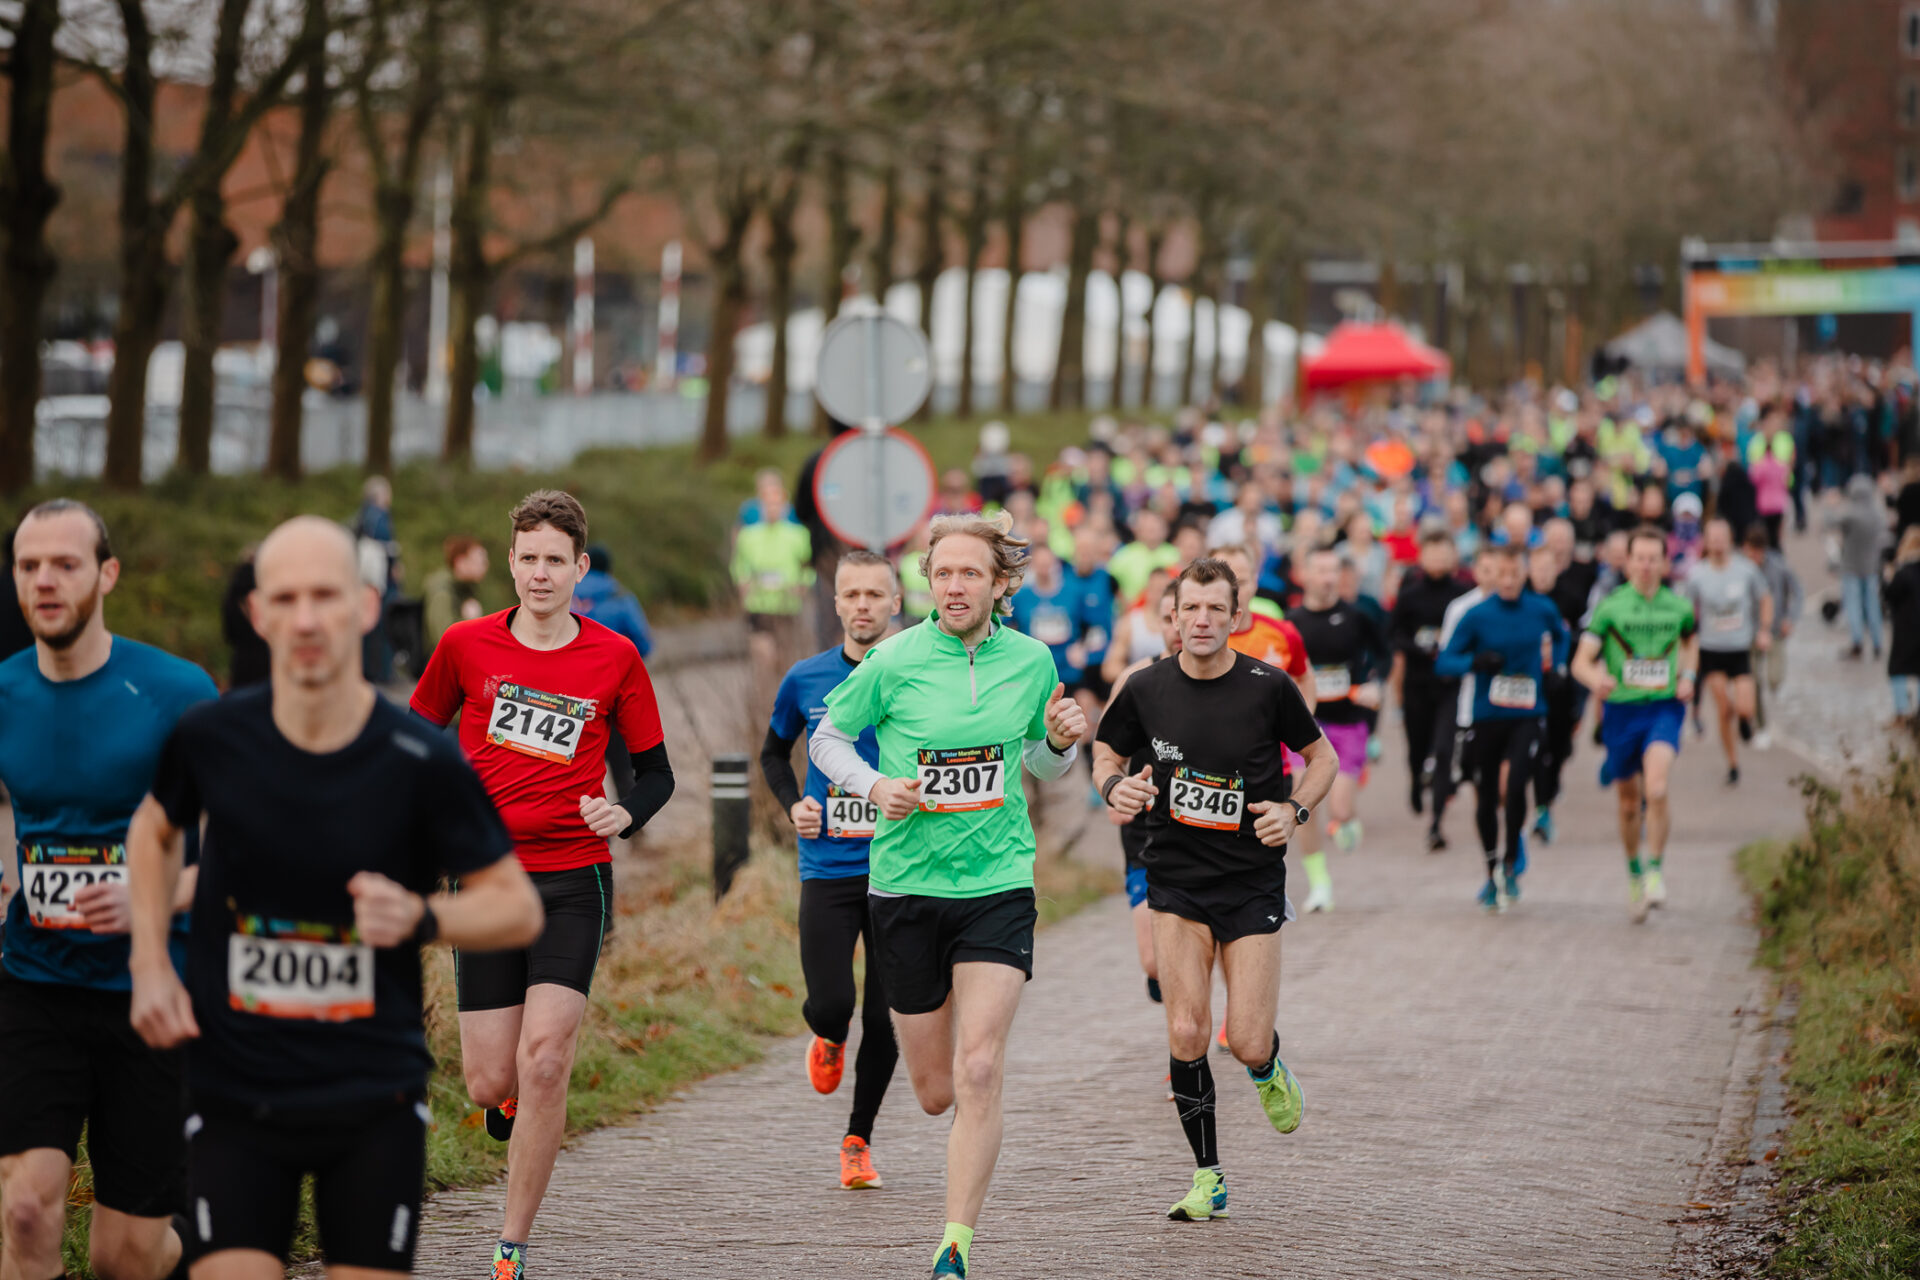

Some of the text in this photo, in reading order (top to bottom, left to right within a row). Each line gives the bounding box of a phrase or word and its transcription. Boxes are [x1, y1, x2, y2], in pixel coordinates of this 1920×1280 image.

[496, 702, 576, 747] 2142
[924, 764, 998, 796] 2307
[1174, 782, 1238, 816] 2346
[243, 945, 358, 990] 2004
